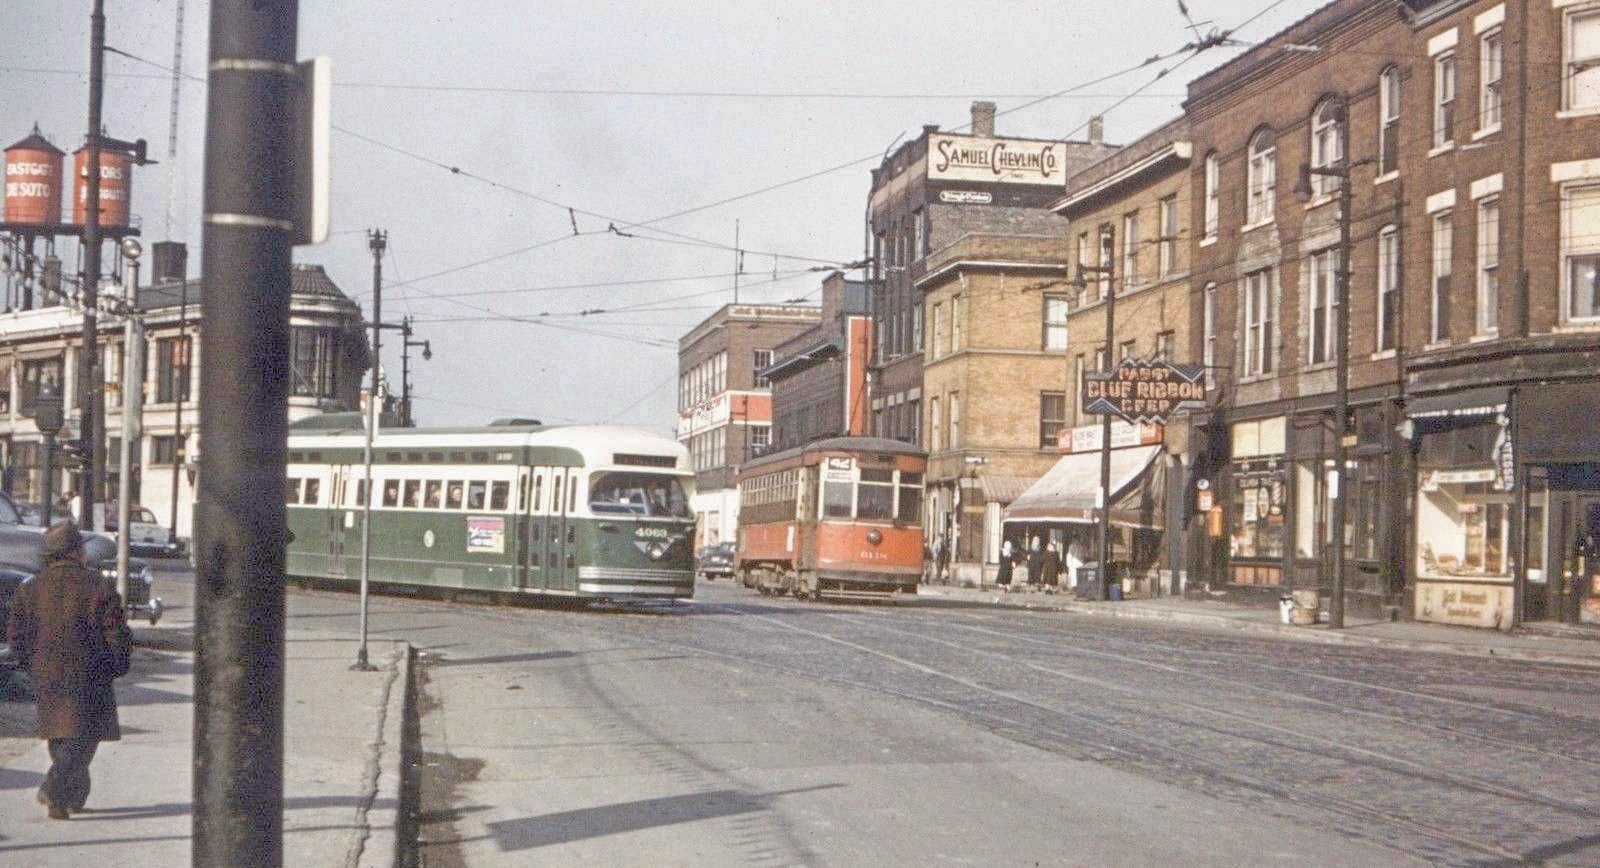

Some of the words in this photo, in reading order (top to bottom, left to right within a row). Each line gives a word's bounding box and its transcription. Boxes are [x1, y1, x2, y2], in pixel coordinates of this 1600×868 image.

[937, 140, 989, 172] SAMUEL
[991, 143, 1040, 175] CHEVLIN
[7, 162, 53, 176] EASTGATE
[6, 182, 18, 197] DE
[19, 182, 50, 198] SOTO
[1120, 367, 1170, 381] PABST
[1087, 380, 1133, 399] BLUE
[1137, 382, 1204, 400] RIBBON
[1121, 399, 1170, 413] BEER
